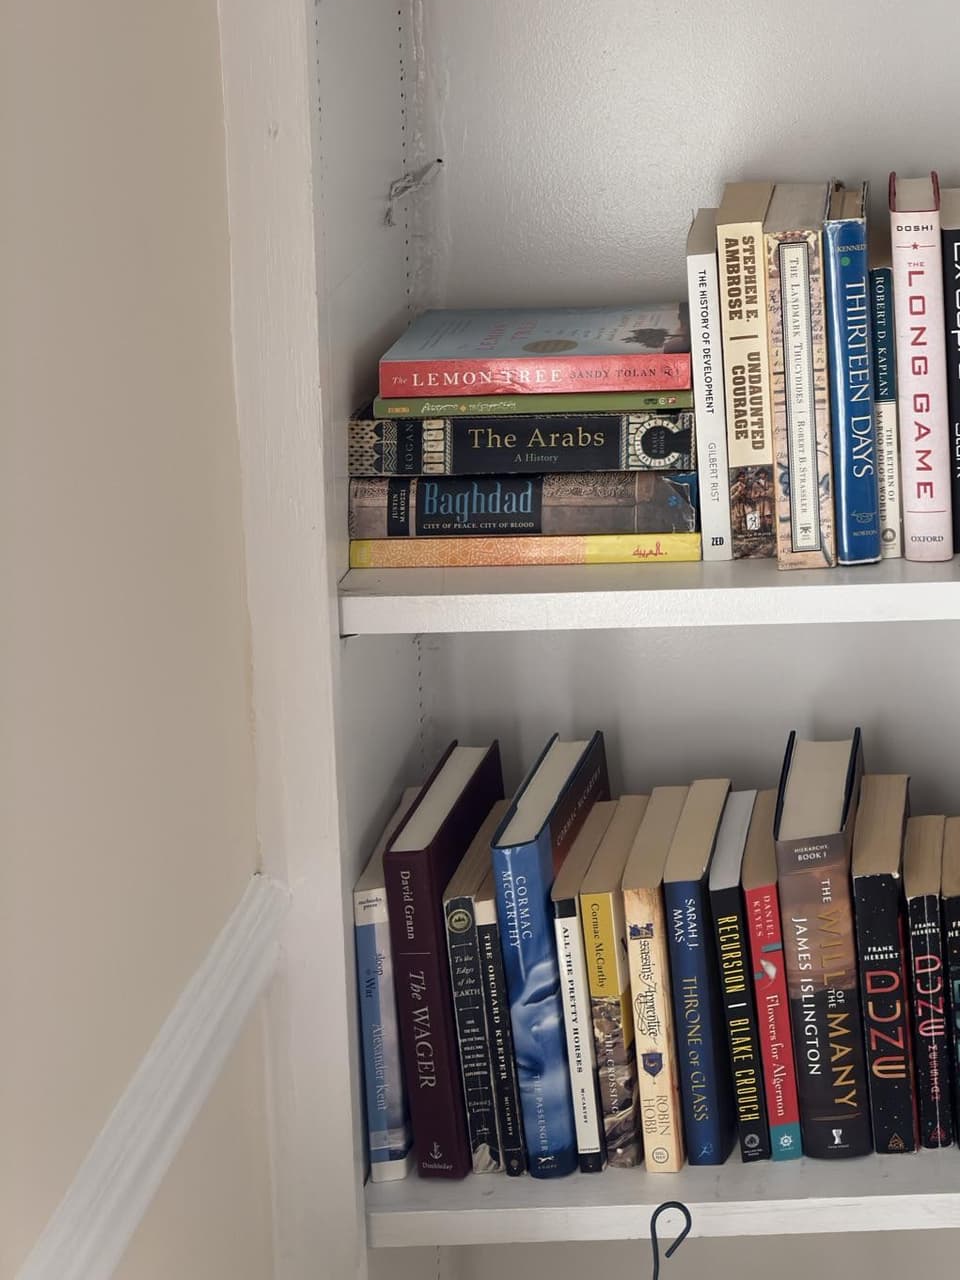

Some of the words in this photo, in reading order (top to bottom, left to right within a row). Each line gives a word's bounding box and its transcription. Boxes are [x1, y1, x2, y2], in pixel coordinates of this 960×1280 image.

[698, 270, 706, 287] THE
[726, 238, 742, 321] AMBROSE
[699, 291, 709, 330] HISTORY
[701, 332, 710, 345] OF
[846, 277, 870, 403] THIRTEEN
[702, 348, 714, 414] DEVELOPMENT
[732, 365, 749, 440] COURAGE
[746, 352, 764, 450] UNDAUNTED
[468, 428, 521, 448] The
[528, 427, 605, 447] Arabs
[852, 415, 873, 477] DAYS
[425, 482, 533, 522] Baghdad
[400, 871, 413, 901] David
[516, 876, 532, 939] CORMAC
[404, 905, 416, 939] Grann
[562, 927, 571, 949] ALL
[590, 903, 602, 939] Cormac
[672, 909, 684, 943] MAAS
[763, 896, 774, 938] DANIEL
[594, 942, 607, 988] McCarthy
[717, 915, 745, 993] RECURSION
[792, 918, 811, 971] JAMES
[409, 970, 425, 1001] The
[568, 980, 579, 1023] PRETTY
[765, 995, 781, 1038] Flowers
[800, 978, 822, 1075] ISLINGTON
[414, 1007, 436, 1088] WAGER
[572, 1028, 582, 1072] HORSES
[729, 1018, 753, 1061] BLAKE
[770, 1043, 784, 1060] for
[827, 1013, 857, 1107] MANY
[735, 1069, 760, 1121] CROUCH
[771, 1063, 787, 1116] Algernon
[644, 1098, 657, 1134] HOBB
[656, 1095, 670, 1135] ROBIN
